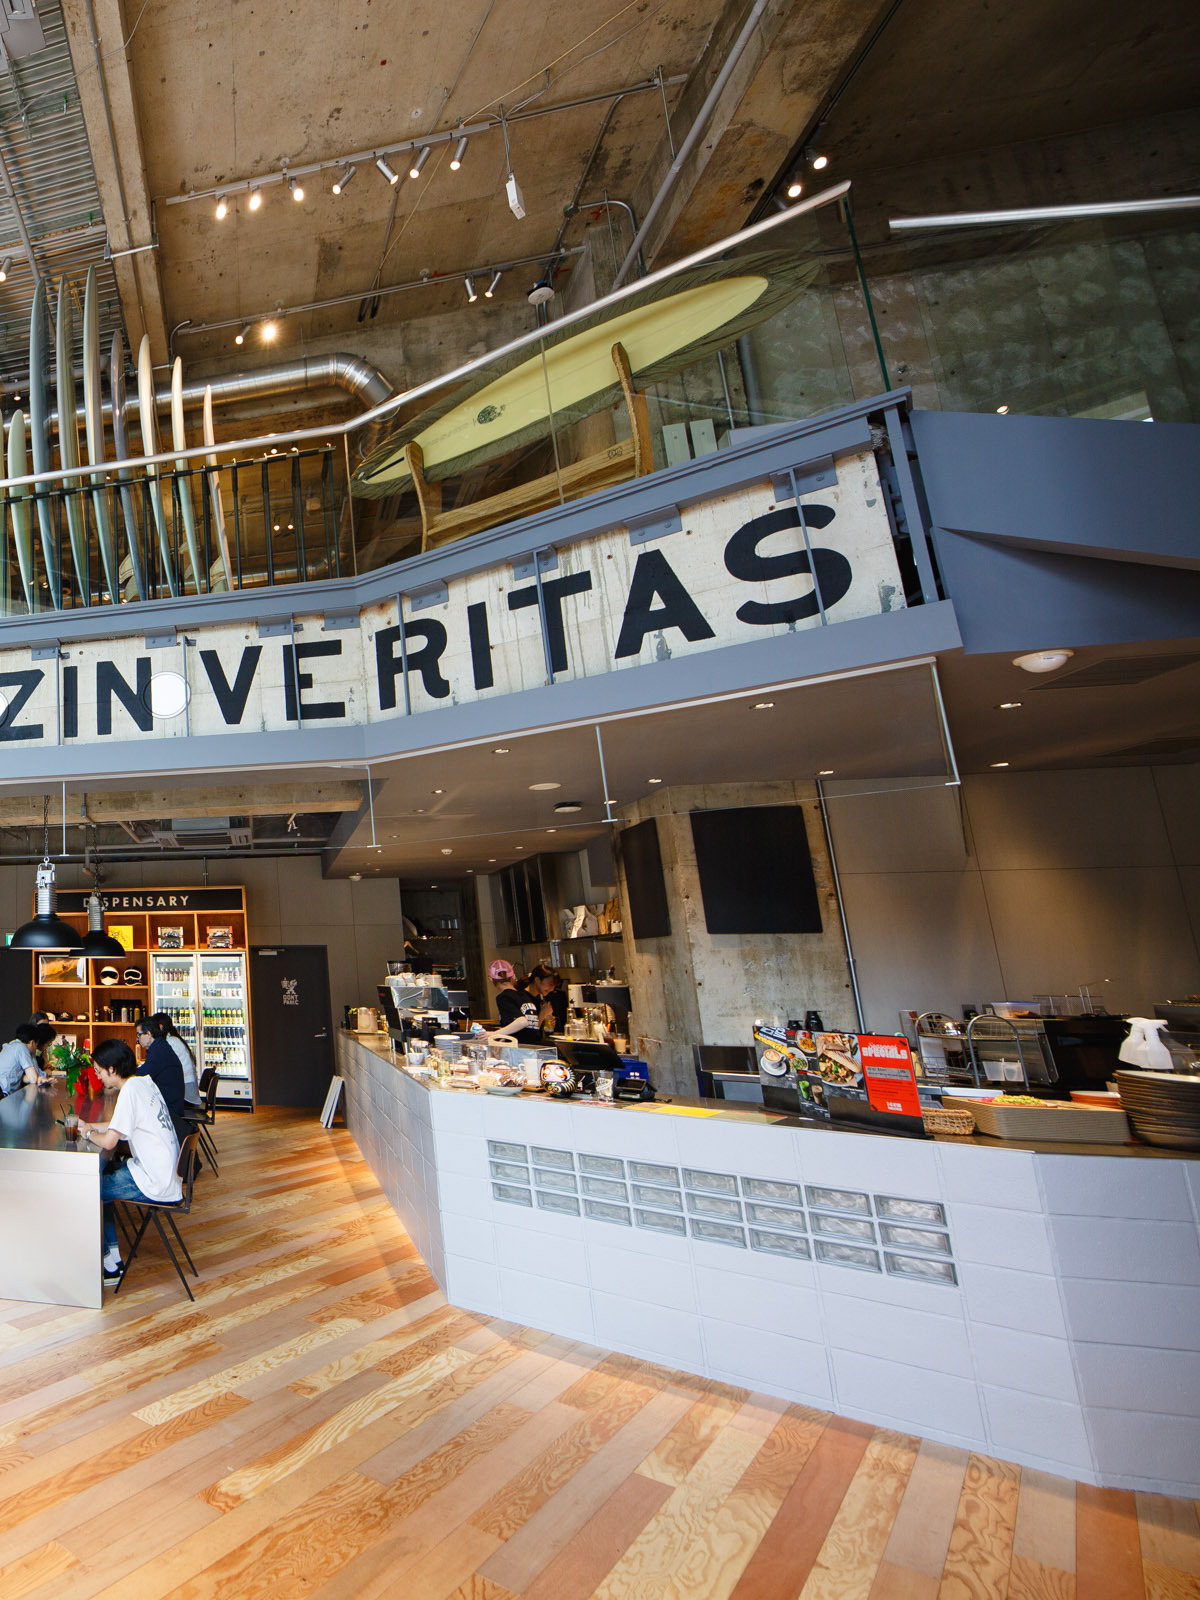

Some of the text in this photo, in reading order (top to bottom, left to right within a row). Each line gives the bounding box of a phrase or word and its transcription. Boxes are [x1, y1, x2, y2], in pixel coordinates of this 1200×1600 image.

[200, 504, 852, 725] VERITAS
[83, 895, 189, 908] DSPENSARY
[861, 1046, 909, 1060] SPECIALS
